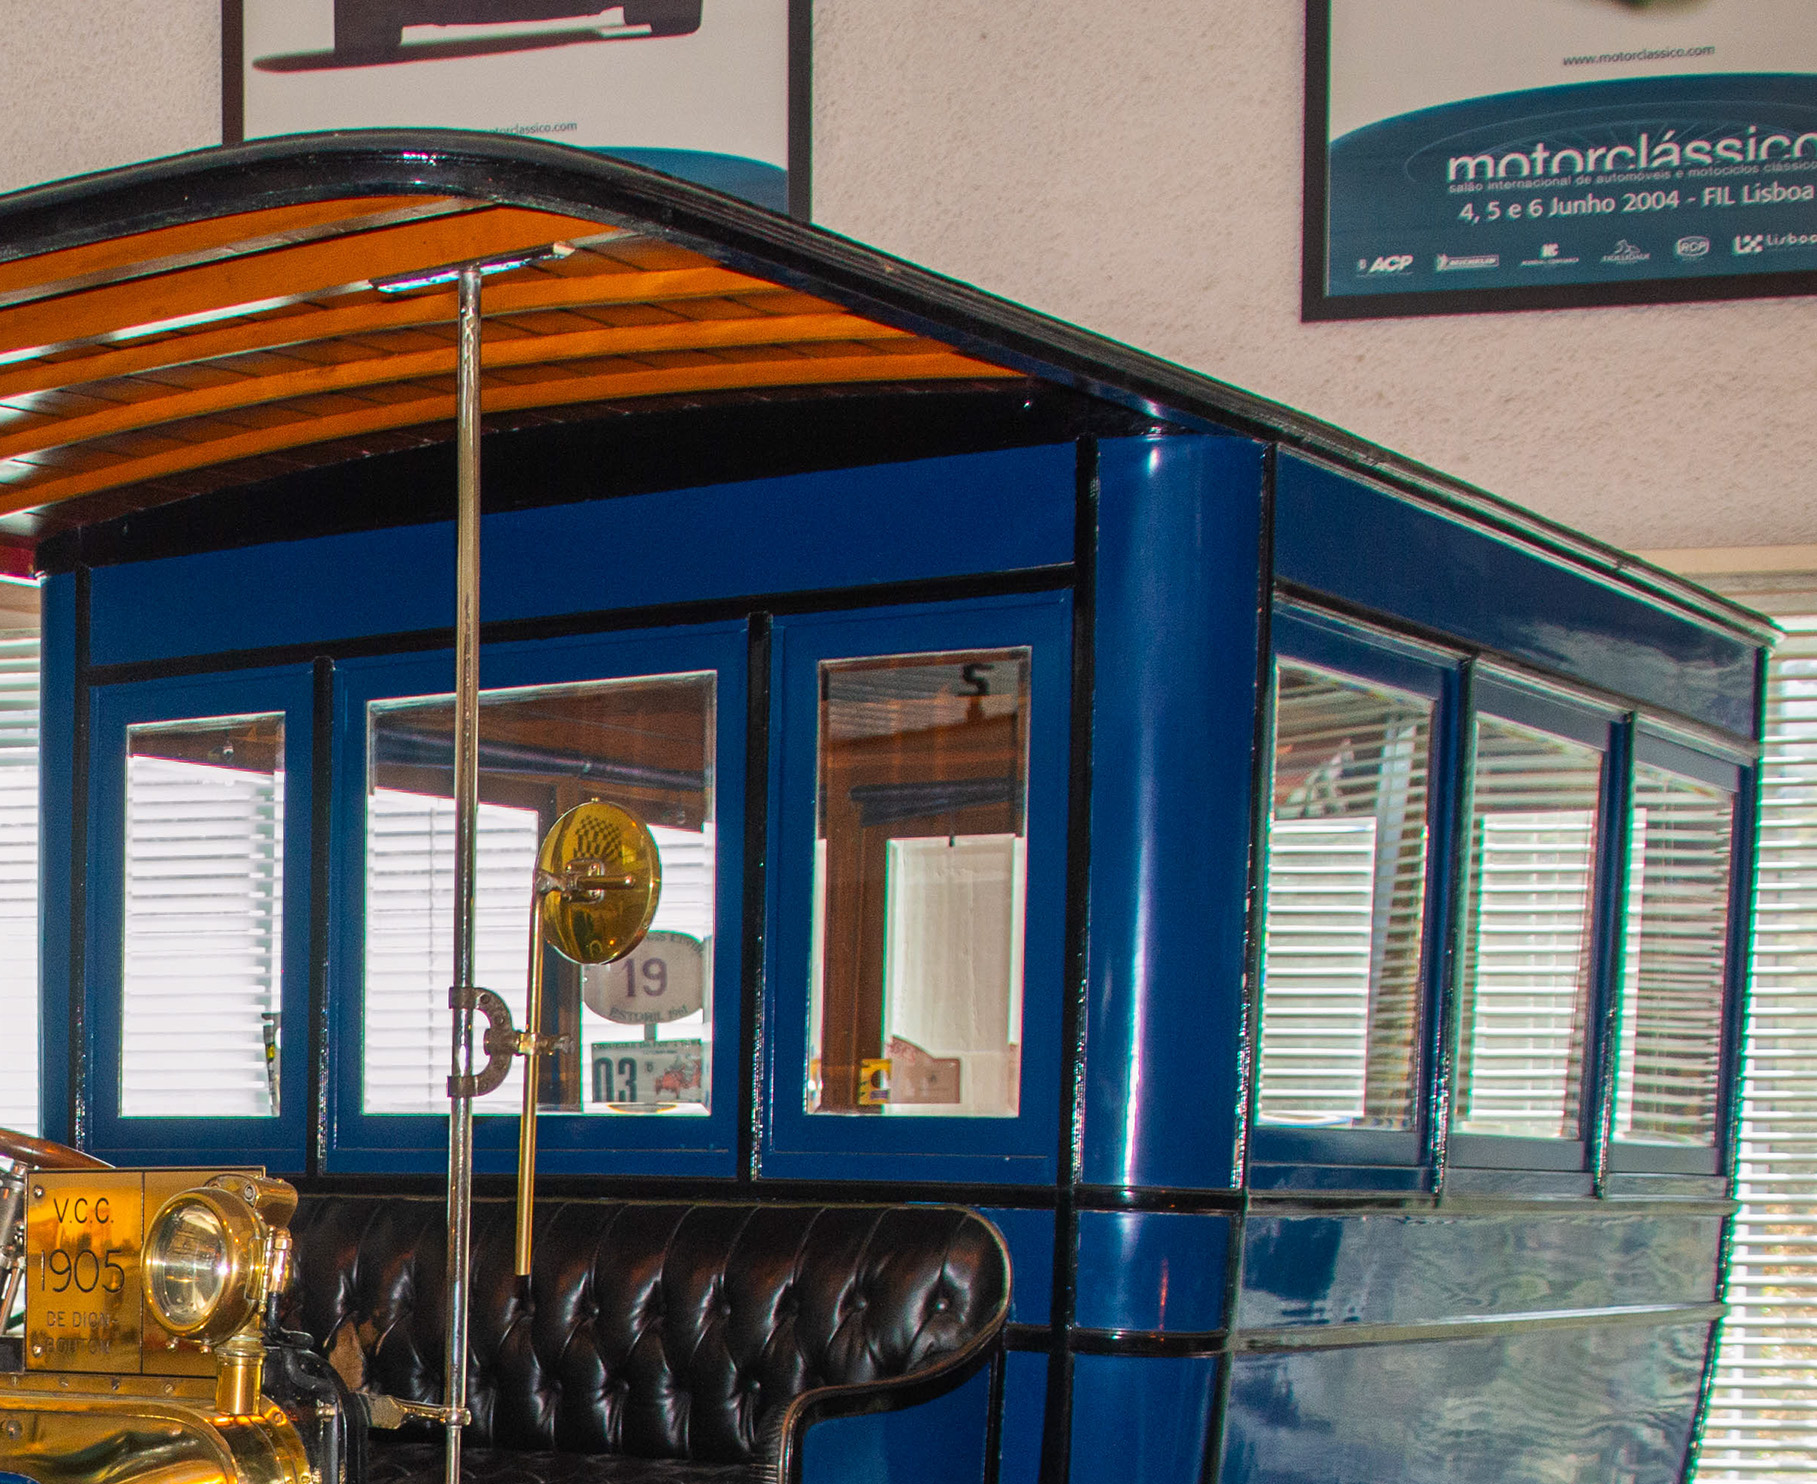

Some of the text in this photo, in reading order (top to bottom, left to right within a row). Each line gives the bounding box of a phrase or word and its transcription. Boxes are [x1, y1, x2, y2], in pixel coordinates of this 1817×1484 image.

[1447, 125, 1817, 182] motorclássico
[1488, 175, 1571, 191] internacional
[1576, 175, 1592, 186] de
[1676, 170, 1684, 179] e
[1688, 164, 1760, 178] motociclos
[1762, 160, 1817, 173] clássico
[1458, 202, 1481, 225] 4,
[1486, 200, 1502, 222] 5
[1507, 202, 1522, 220] e
[1527, 198, 1544, 219] 6
[1548, 192, 1616, 218] Junho
[1621, 189, 1680, 213] 2004
[1701, 185, 1736, 208] FIL
[1740, 180, 1816, 206] Lisboa
[1368, 254, 1414, 274] ACP
[621, 958, 668, 998] 19
[53, 1197, 114, 1225] V.C.C.
[40, 1249, 125, 1294] 1905
[46, 1310, 66, 1328] DE
